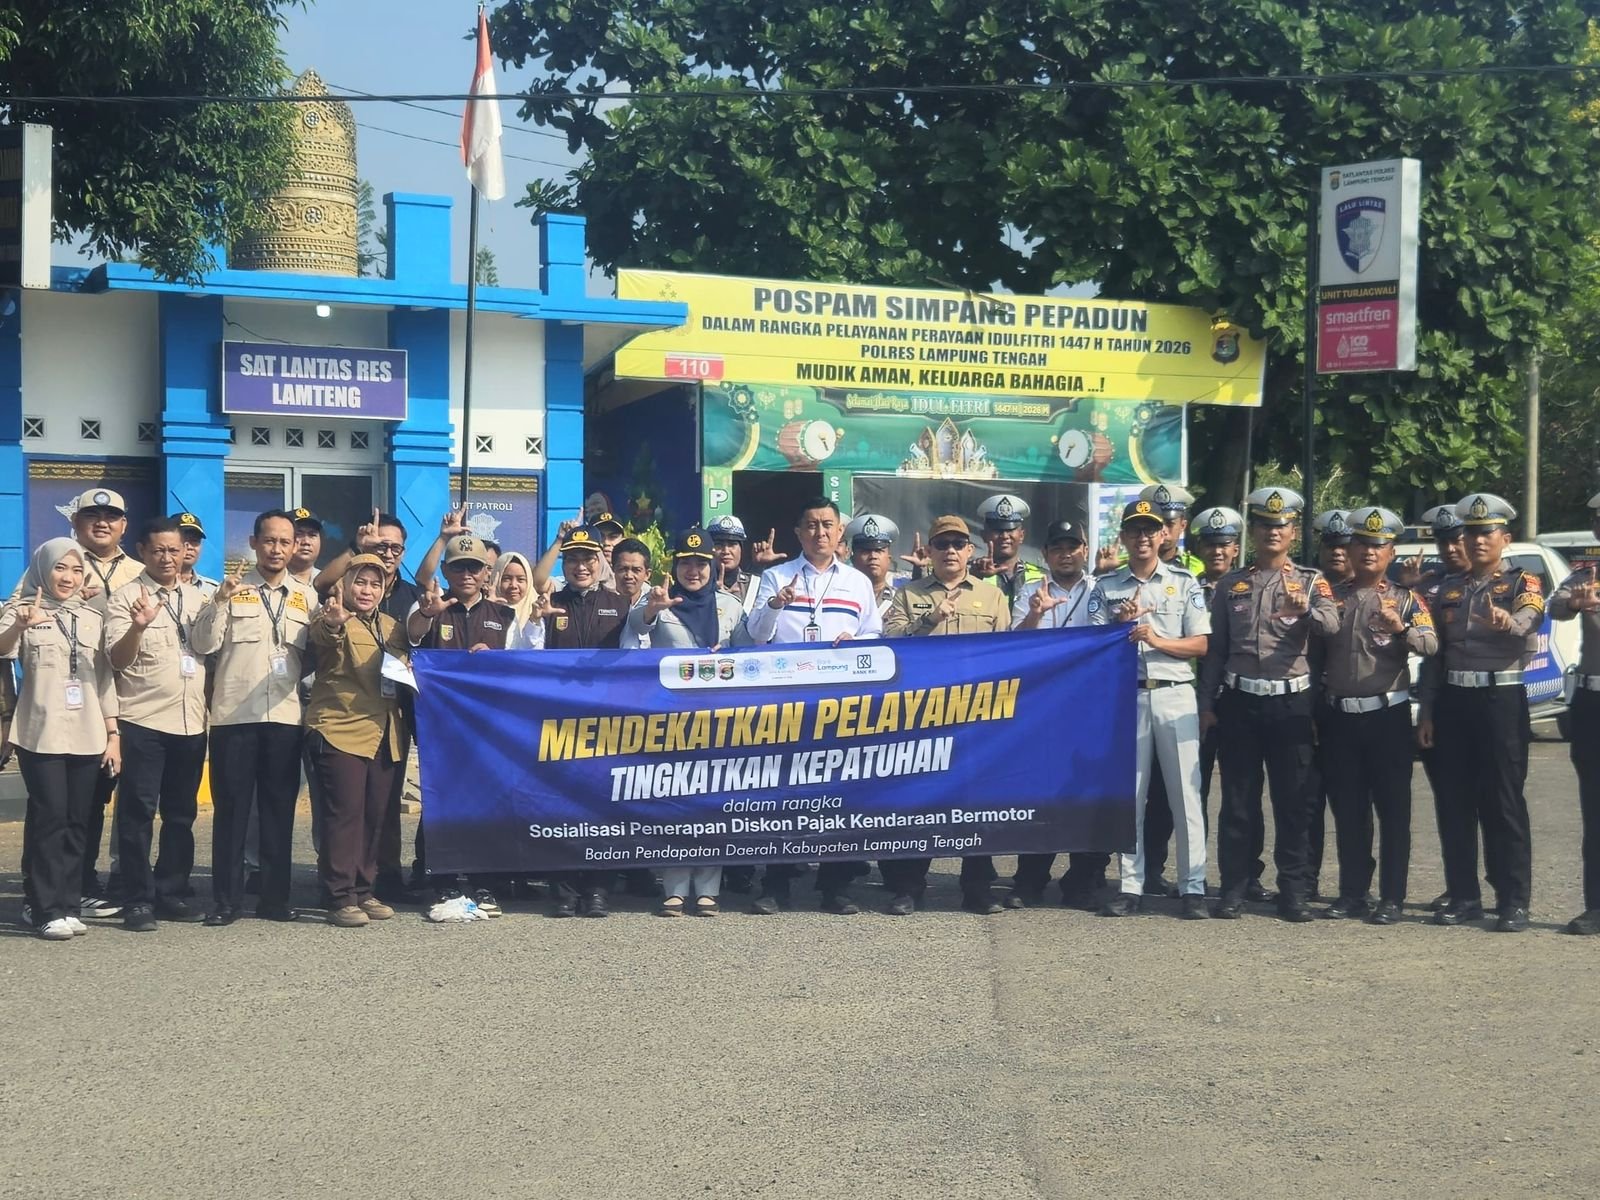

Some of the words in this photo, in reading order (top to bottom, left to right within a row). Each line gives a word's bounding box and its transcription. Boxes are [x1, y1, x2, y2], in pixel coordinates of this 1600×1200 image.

[1340, 201, 1357, 213] LALU
[1358, 199, 1382, 208] LINTAS
[1321, 290, 1341, 300] UNIT
[754, 287, 877, 318] POSPAM
[885, 295, 1016, 326] SIMPANG
[1024, 304, 1148, 332] PEPADUN
[1326, 306, 1392, 325] smartfren
[702, 315, 755, 333] DALAM
[760, 319, 822, 336] RANGKA
[826, 323, 908, 342] PELAYANAN
[912, 328, 984, 345] PERAYAAN
[988, 332, 1055, 348] IDULFITRI
[1060, 335, 1090, 350] 1447
[1094, 337, 1103, 351] H
[1108, 338, 1151, 353] TAHUN
[1155, 340, 1191, 355] 2026
[680, 359, 710, 376] 110
[861, 344, 915, 360] POLRES
[919, 348, 988, 364] LAMPUNG
[992, 351, 1047, 367] TENGAH
[239, 353, 276, 377] SAT
[280, 356, 353, 381] LANTAS
[356, 360, 392, 383] RES
[797, 362, 857, 381] MUDIK
[860, 366, 915, 386] AMAN,
[919, 369, 1005, 389] KELUARGA
[1010, 374, 1084, 392] BAHAGIA
[272, 383, 361, 409] LAMTENG
[846, 394, 874, 409] Selamat
[873, 393, 891, 410] Hari
[890, 396, 909, 410] Raya
[911, 396, 949, 414] IDUL
[951, 398, 990, 416] FITRI
[993, 402, 1012, 414] 1447
[1023, 404, 1041, 416] 2026
[452, 502, 474, 510] UT
[476, 502, 513, 511] PATROLI
[817, 663, 849, 671] Lampung
[538, 702, 805, 762] MENDEKATKAN
[813, 678, 1021, 741] PELAYANAN
[610, 754, 782, 802] TINGKATKAN
[788, 736, 954, 786] KEPATUHAN
[722, 798, 776, 813] dalam
[782, 794, 843, 813] rangka
[529, 822, 626, 839] Sosialisasi
[630, 819, 727, 838] Penerapan
[731, 817, 793, 834] Diskon
[797, 813, 846, 833] Pajak
[850, 811, 947, 829] Kendaraan
[951, 807, 1036, 824] Bermotor
[585, 847, 630, 861] Badan
[635, 844, 720, 861] Pendapatan
[726, 842, 777, 857] Daerah
[782, 841, 858, 856] Kabupaten
[863, 837, 928, 852] Lampung
[932, 833, 982, 850] Tengah
